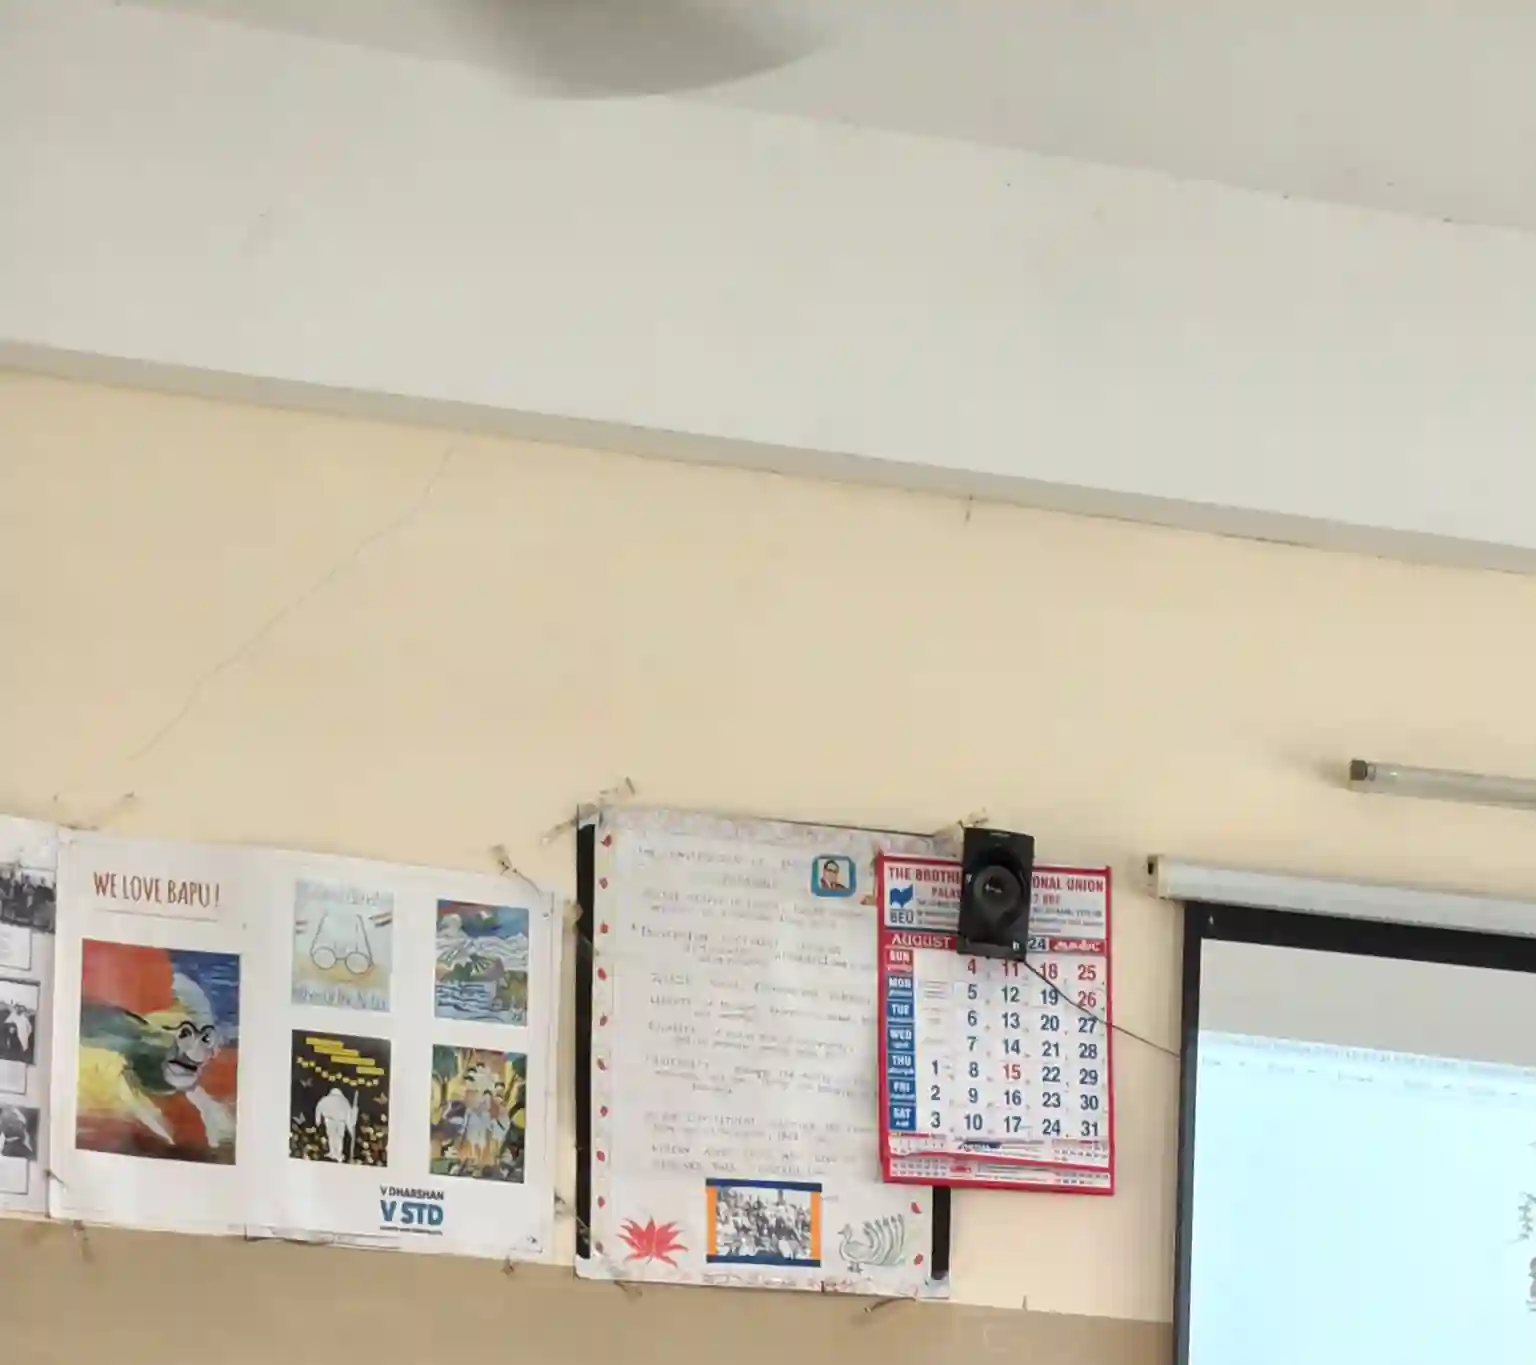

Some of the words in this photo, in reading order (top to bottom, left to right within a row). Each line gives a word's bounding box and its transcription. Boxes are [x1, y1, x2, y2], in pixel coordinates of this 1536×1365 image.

[93, 871, 117, 898] WE
[122, 875, 162, 904] LOVE
[889, 867, 911, 881] THE
[1067, 878, 1104, 892] UNION
[891, 934, 953, 949] AUGUST
[889, 950, 910, 962] SUN
[967, 958, 977, 975] 4
[1001, 958, 1020, 977] 11
[1040, 963, 1058, 980] 18
[1078, 965, 1097, 981] 25
[888, 977, 912, 989] MON
[967, 983, 978, 1000] 5
[1002, 986, 1020, 1003] 12
[1040, 989, 1059, 1006] 19
[1078, 991, 1097, 1008] 26
[891, 1003, 910, 1016] TUE
[967, 1010, 977, 1026] 6
[1002, 1012, 1021, 1029] 13
[1040, 1015, 1060, 1031] 20
[1078, 1017, 1097, 1034] 27
[889, 1029, 912, 1041] WED
[967, 1036, 977, 1051] 7
[1003, 1038, 1021, 1055] 14
[1042, 1040, 1060, 1057] 21
[1079, 1043, 1098, 1060] 28
[891, 1054, 912, 1067] THU
[931, 1060, 938, 1076] 1
[968, 1062, 979, 1078] 8
[1003, 1064, 1021, 1080] 15
[1042, 1066, 1061, 1082] 22
[1079, 1068, 1098, 1085] 29
[893, 1081, 910, 1093] FRI
[930, 1085, 941, 1101] 2
[968, 1087, 979, 1104] 9
[1004, 1090, 1022, 1106] 16
[1042, 1092, 1061, 1108] 23
[1080, 1094, 1099, 1111] 30
[893, 1107, 911, 1119] SAT
[930, 1112, 941, 1128] 3
[964, 1114, 983, 1130] 10
[1003, 1116, 1022, 1133] 17
[1042, 1118, 1061, 1135] 24
[1081, 1121, 1099, 1137] 31
[380, 1199, 397, 1222] V
[400, 1201, 444, 1226] STD
